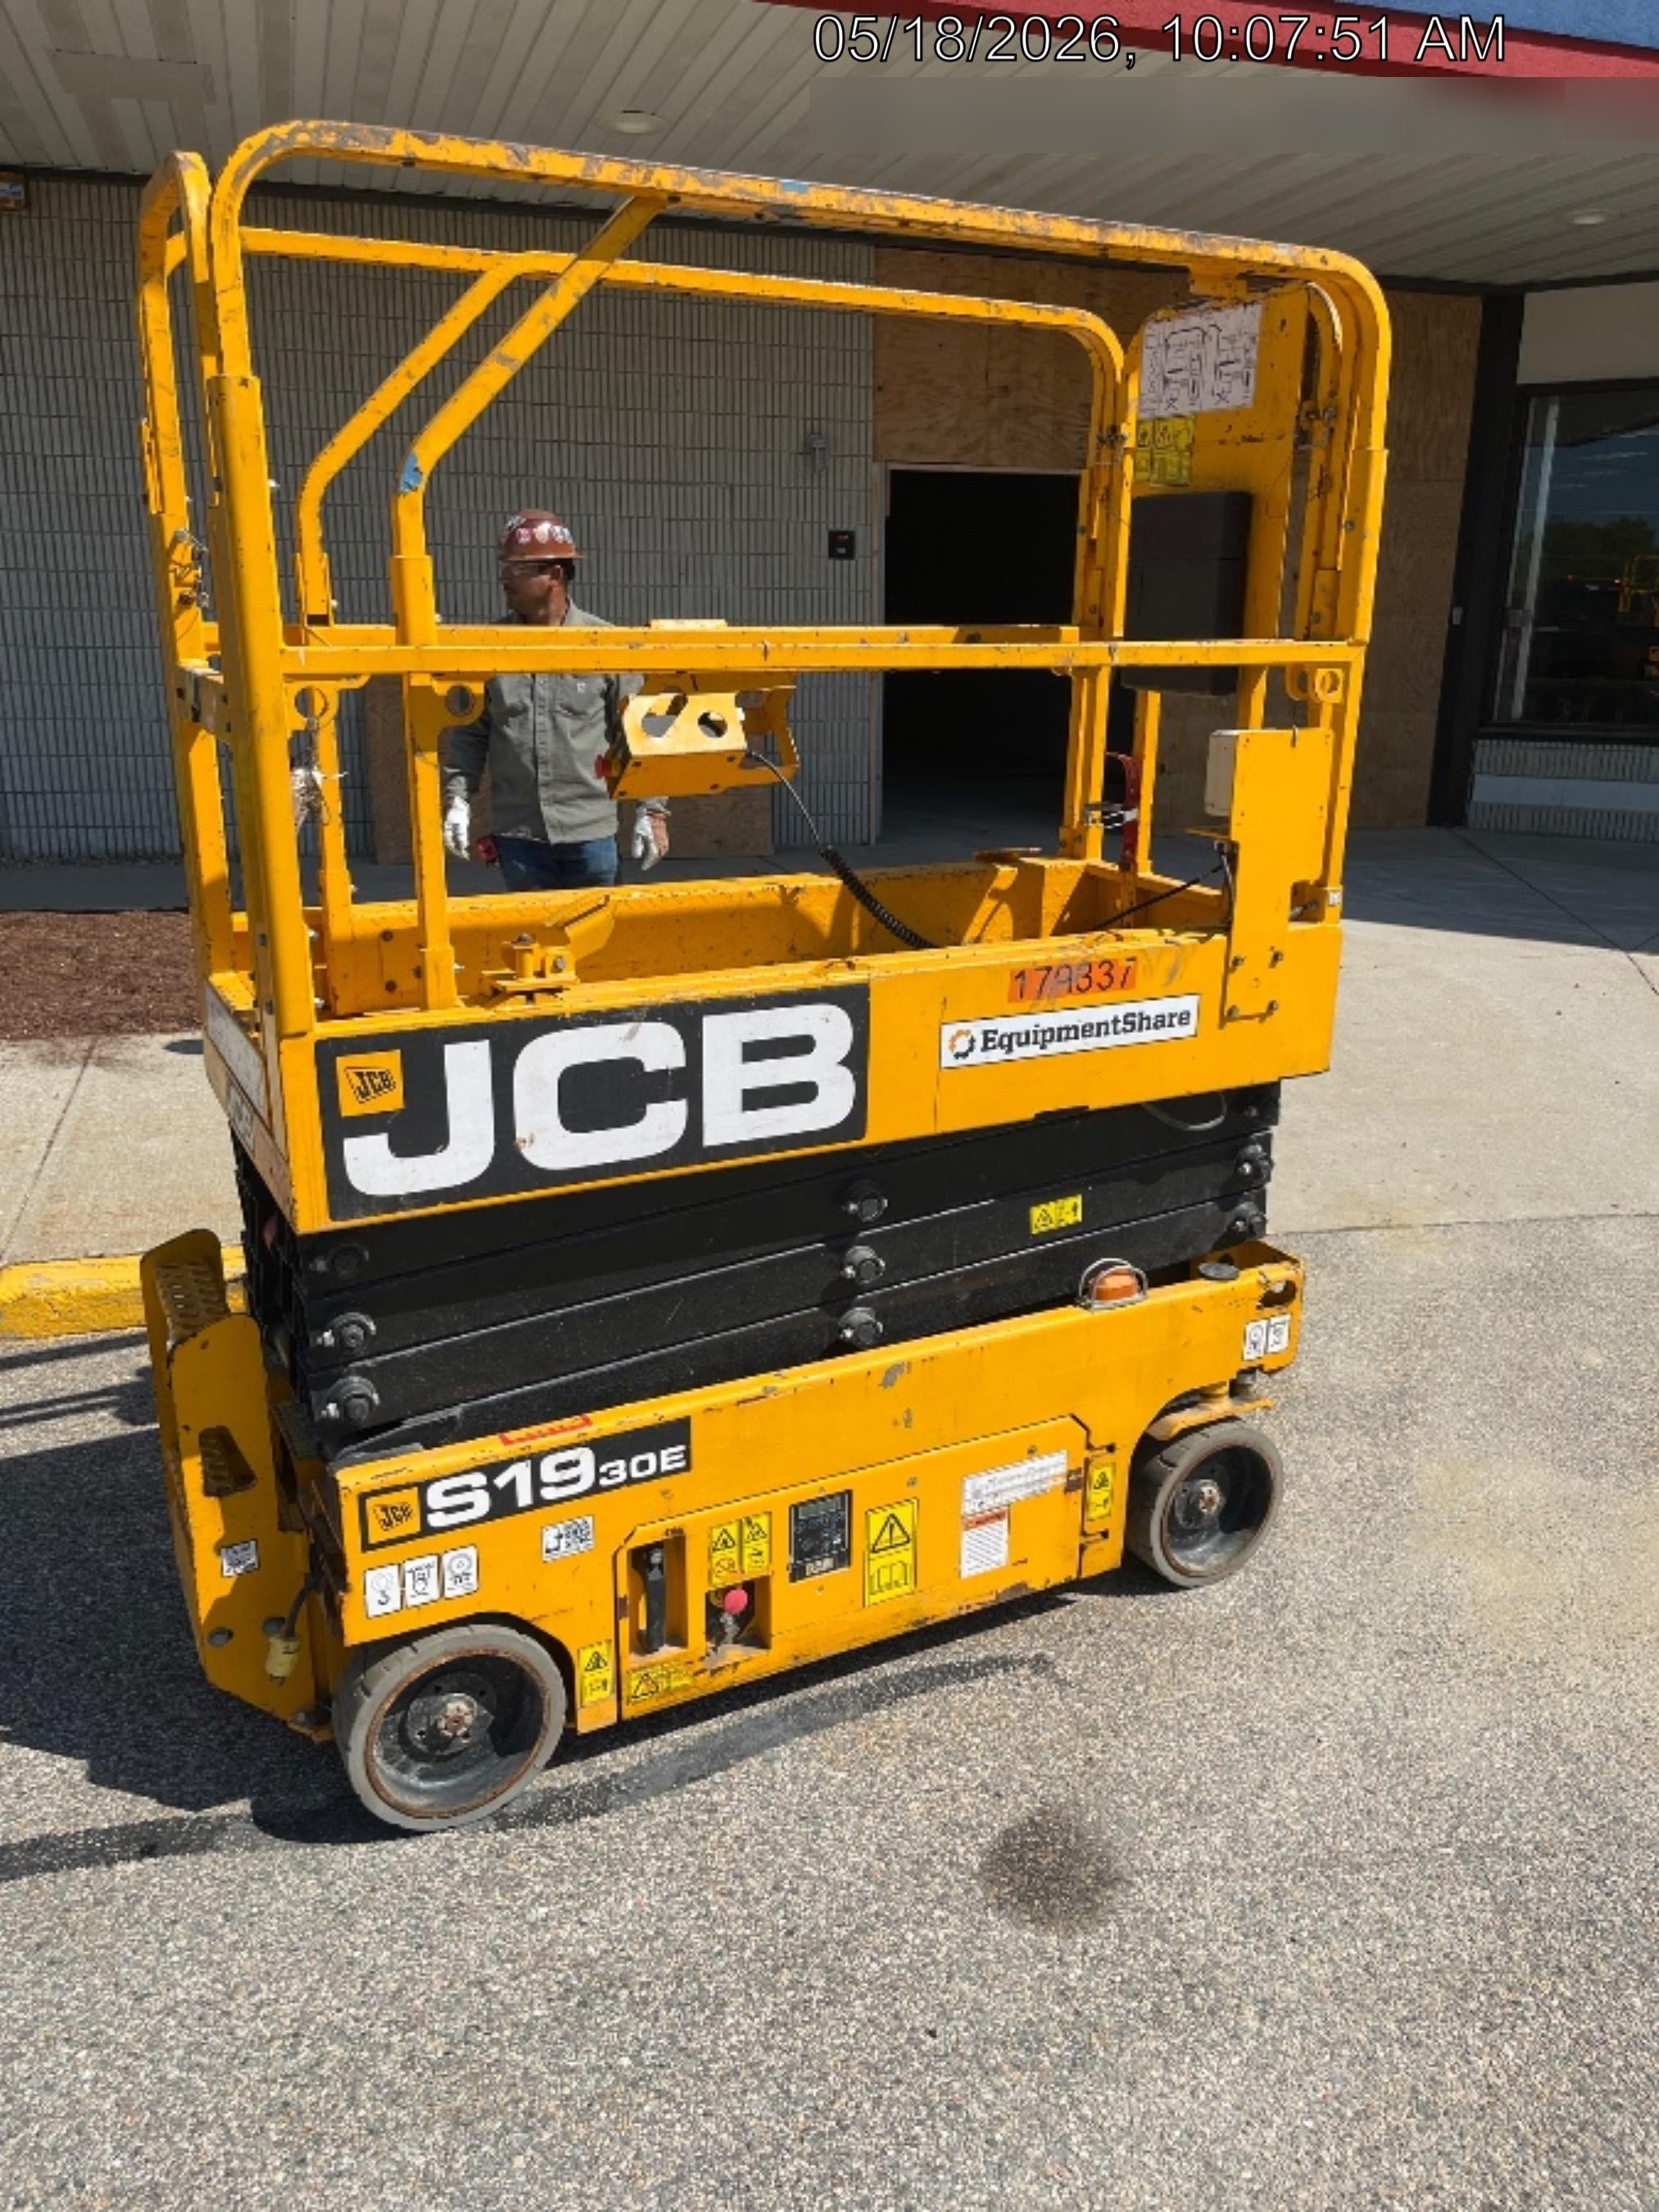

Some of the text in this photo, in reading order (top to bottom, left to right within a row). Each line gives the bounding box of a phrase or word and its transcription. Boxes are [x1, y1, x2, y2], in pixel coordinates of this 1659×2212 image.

[979, 1009, 1191, 1055] EquipmentShare
[342, 1003, 856, 1197] JCB
[352, 1070, 393, 1099] JCB
